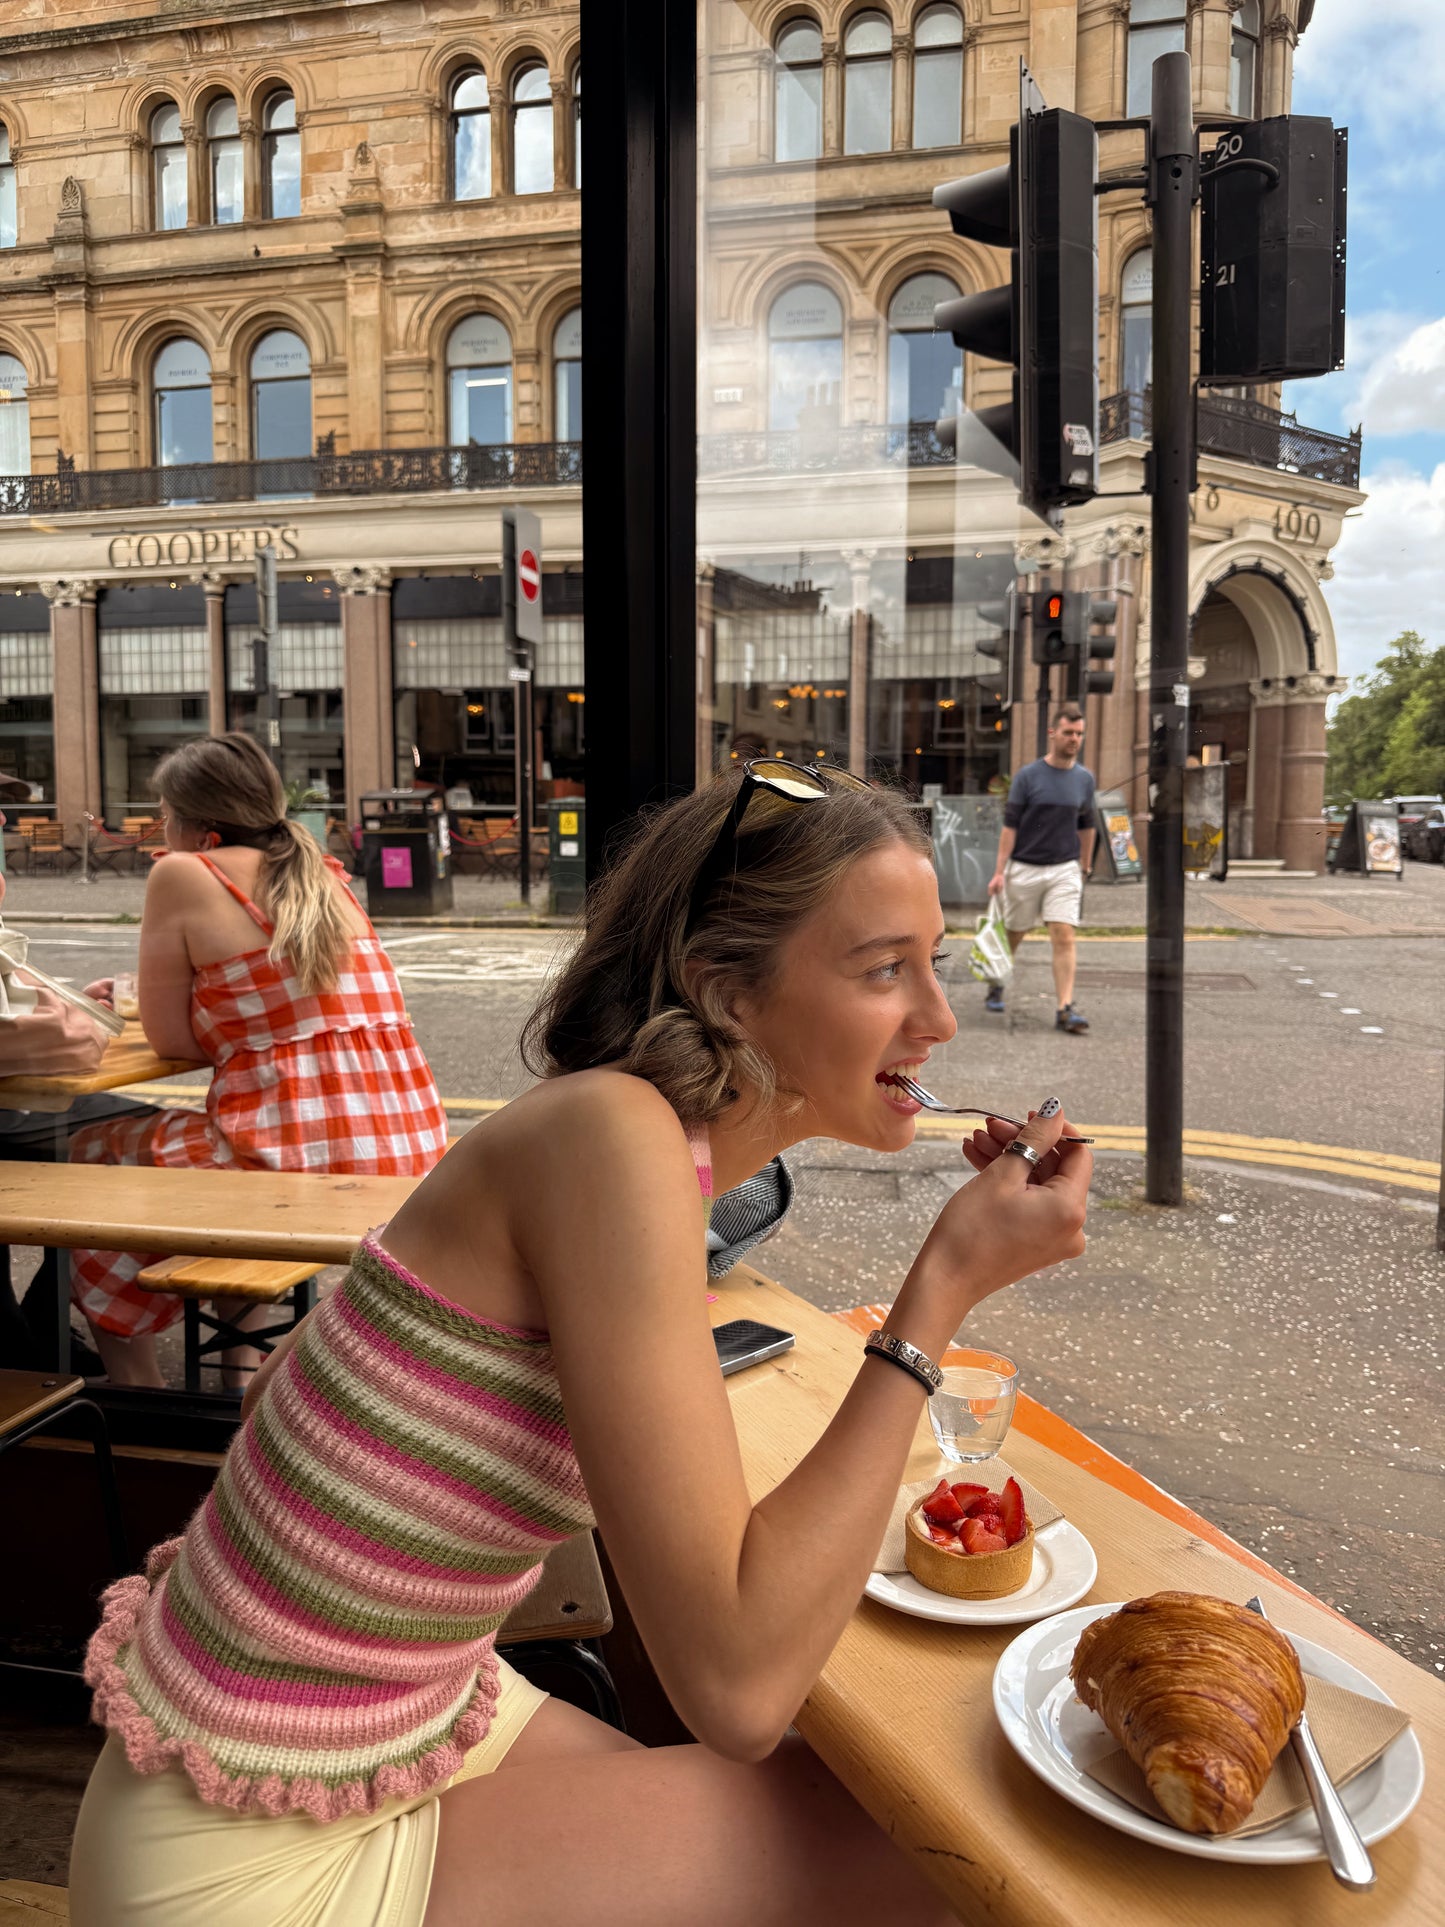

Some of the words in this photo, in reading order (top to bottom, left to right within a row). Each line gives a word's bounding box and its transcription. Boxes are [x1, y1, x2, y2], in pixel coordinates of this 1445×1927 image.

[1216, 134, 1243, 163] 20
[1215, 263, 1236, 287] 21
[108, 527, 300, 568] COOPERS
